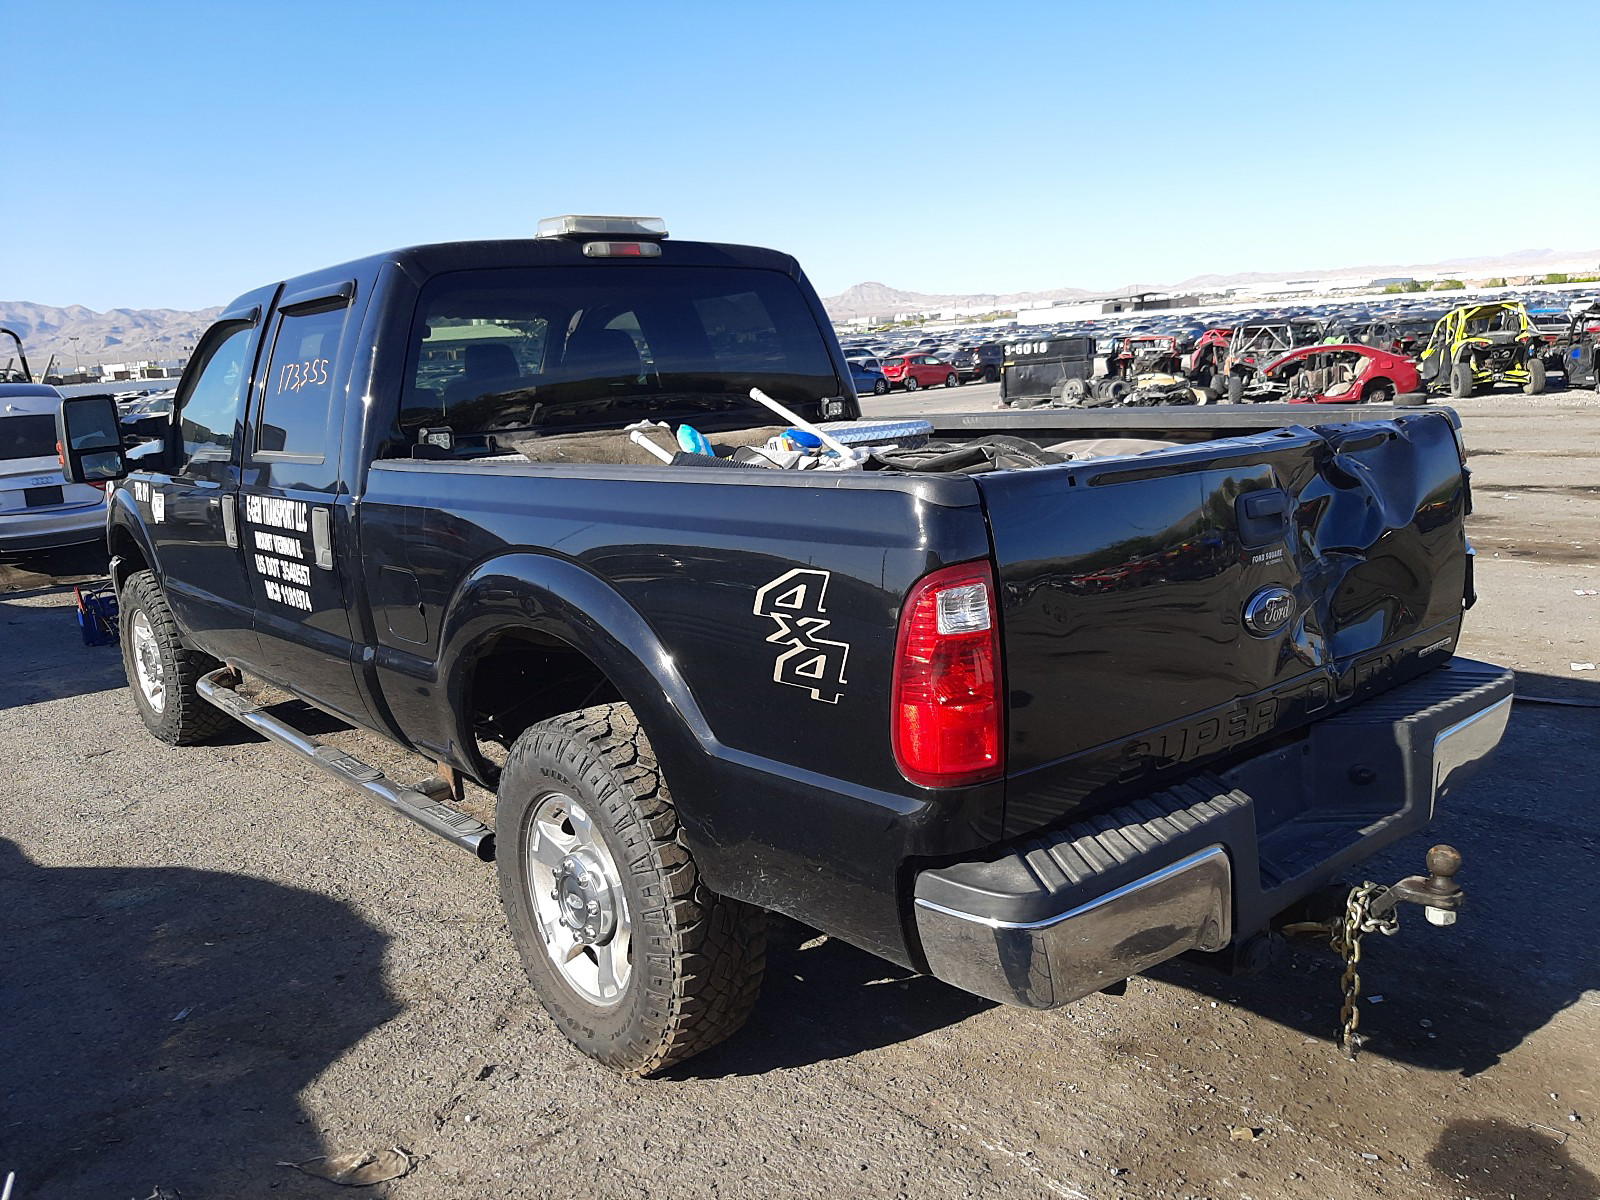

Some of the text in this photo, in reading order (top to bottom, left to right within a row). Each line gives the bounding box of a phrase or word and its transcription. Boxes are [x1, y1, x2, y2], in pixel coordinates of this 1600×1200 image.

[278, 359, 328, 394] 173,355
[262, 496, 295, 530] TRANSPORT
[295, 501, 308, 533] LLC
[273, 534, 297, 557] VERNON
[254, 553, 267, 574] US
[265, 556, 281, 578] DOT
[1264, 595, 1291, 625] Ford
[1117, 696, 1280, 784] SUPER
